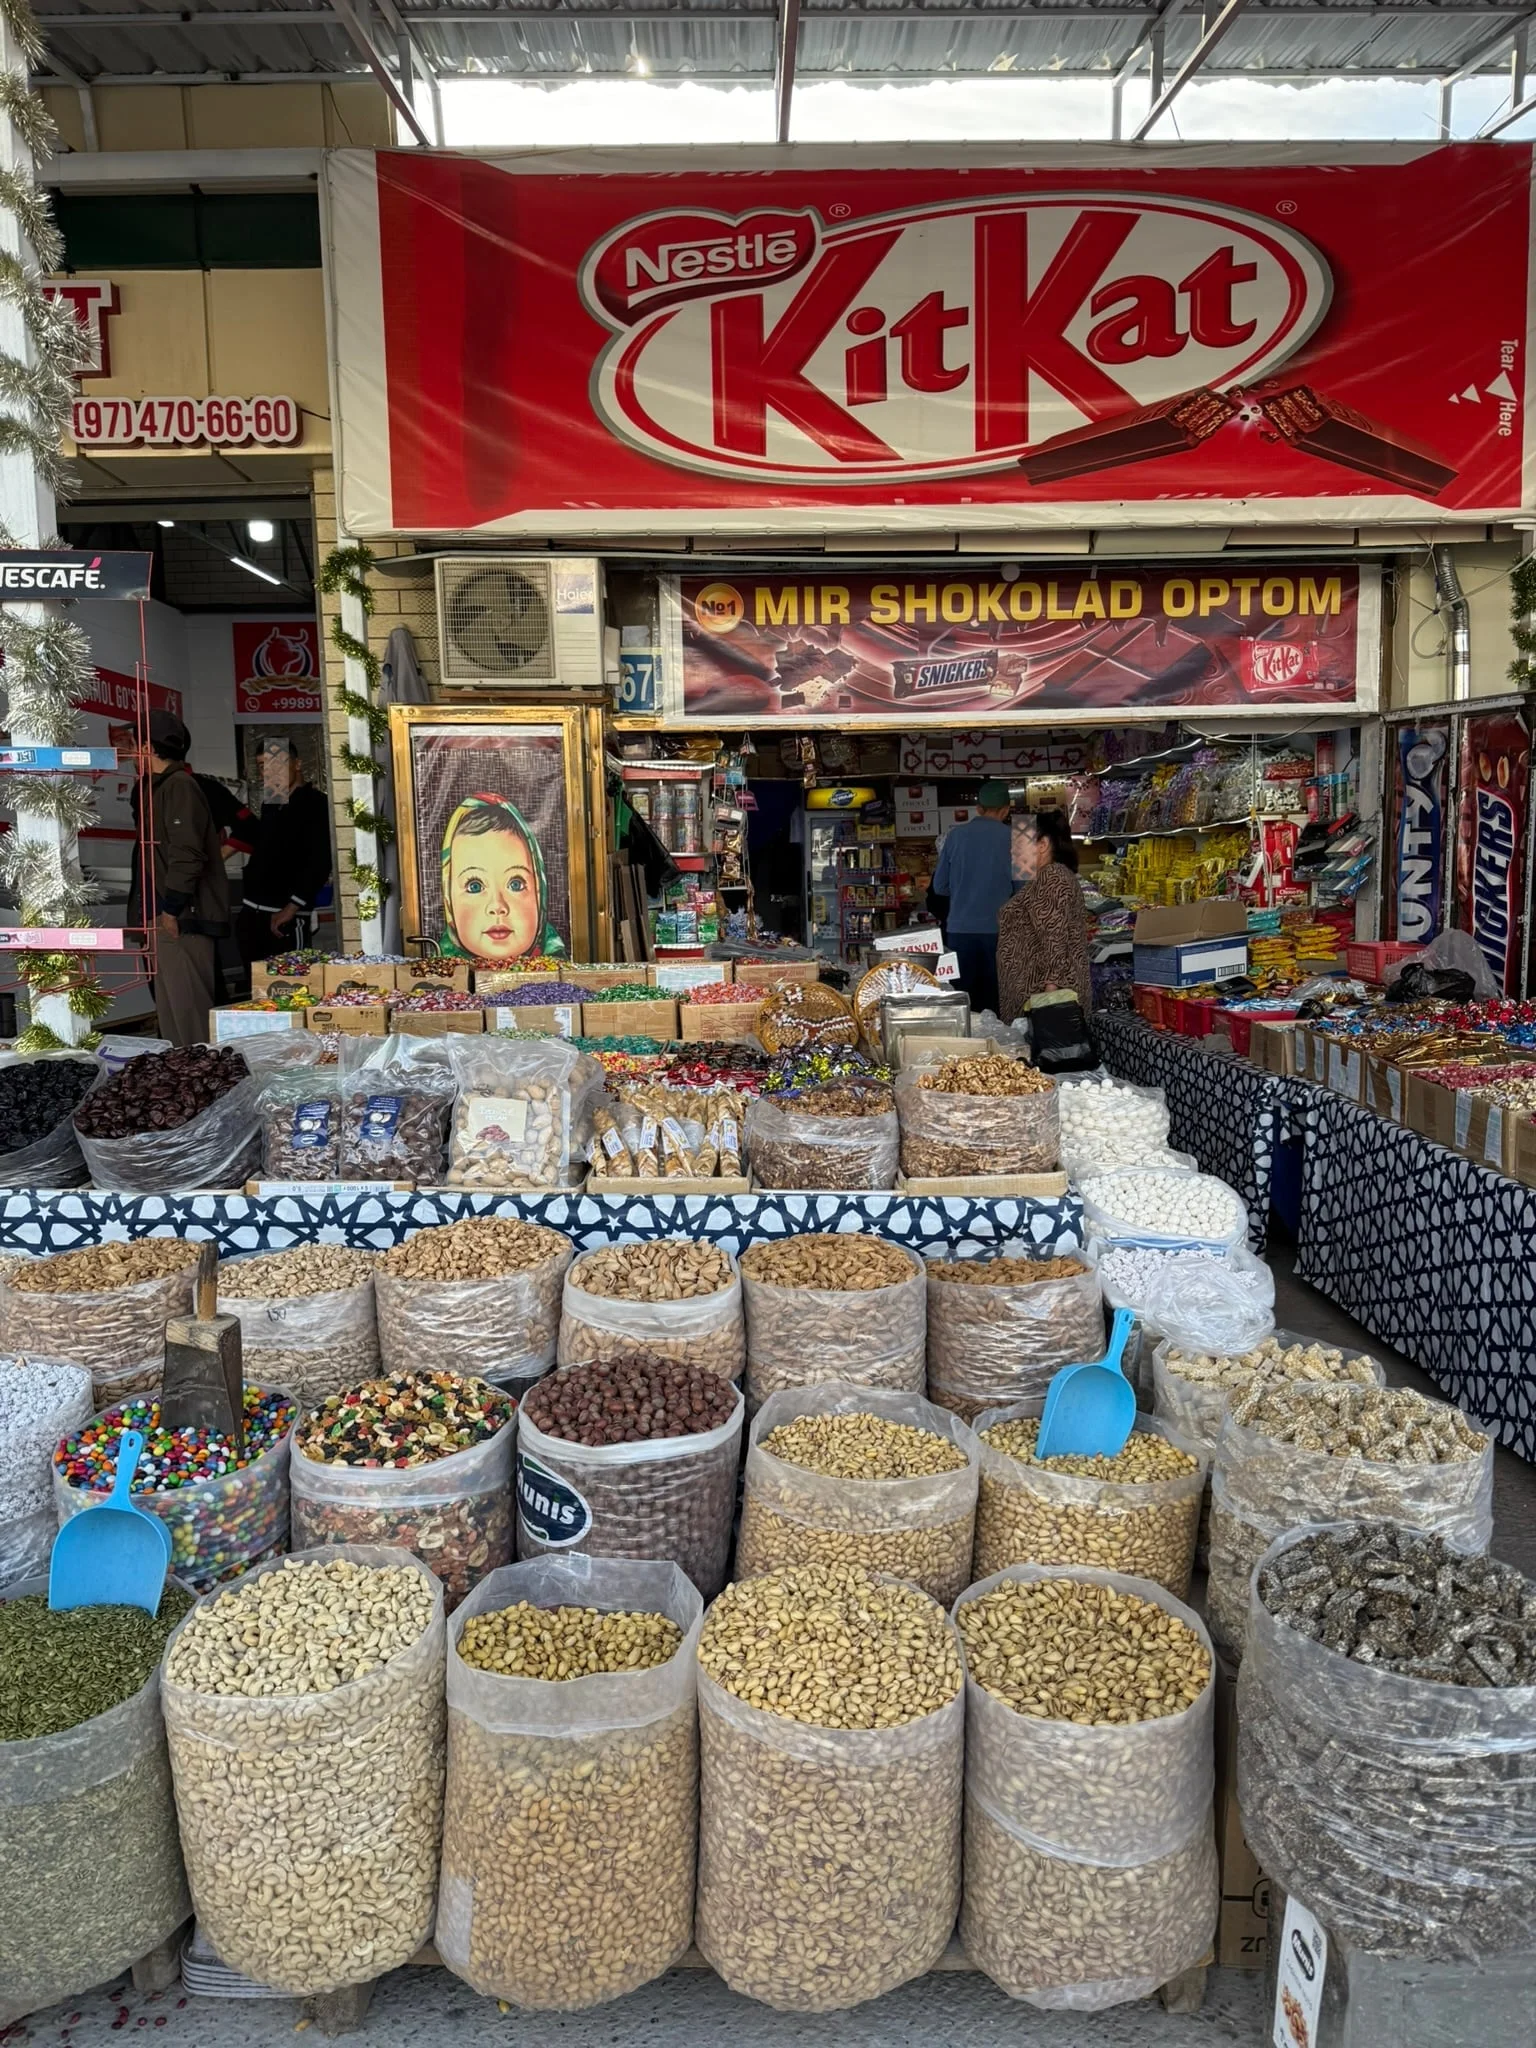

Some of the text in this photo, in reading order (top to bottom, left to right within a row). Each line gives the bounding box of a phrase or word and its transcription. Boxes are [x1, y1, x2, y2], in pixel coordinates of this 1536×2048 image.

[625, 230, 797, 288] Nestlé
[711, 209, 1258, 462] KitKat
[1498, 339, 1518, 436] Tear Here
[755, 577, 1342, 625] MIR SHOKOLAD OPTOM
[1472, 788, 1513, 988] NICKERS
